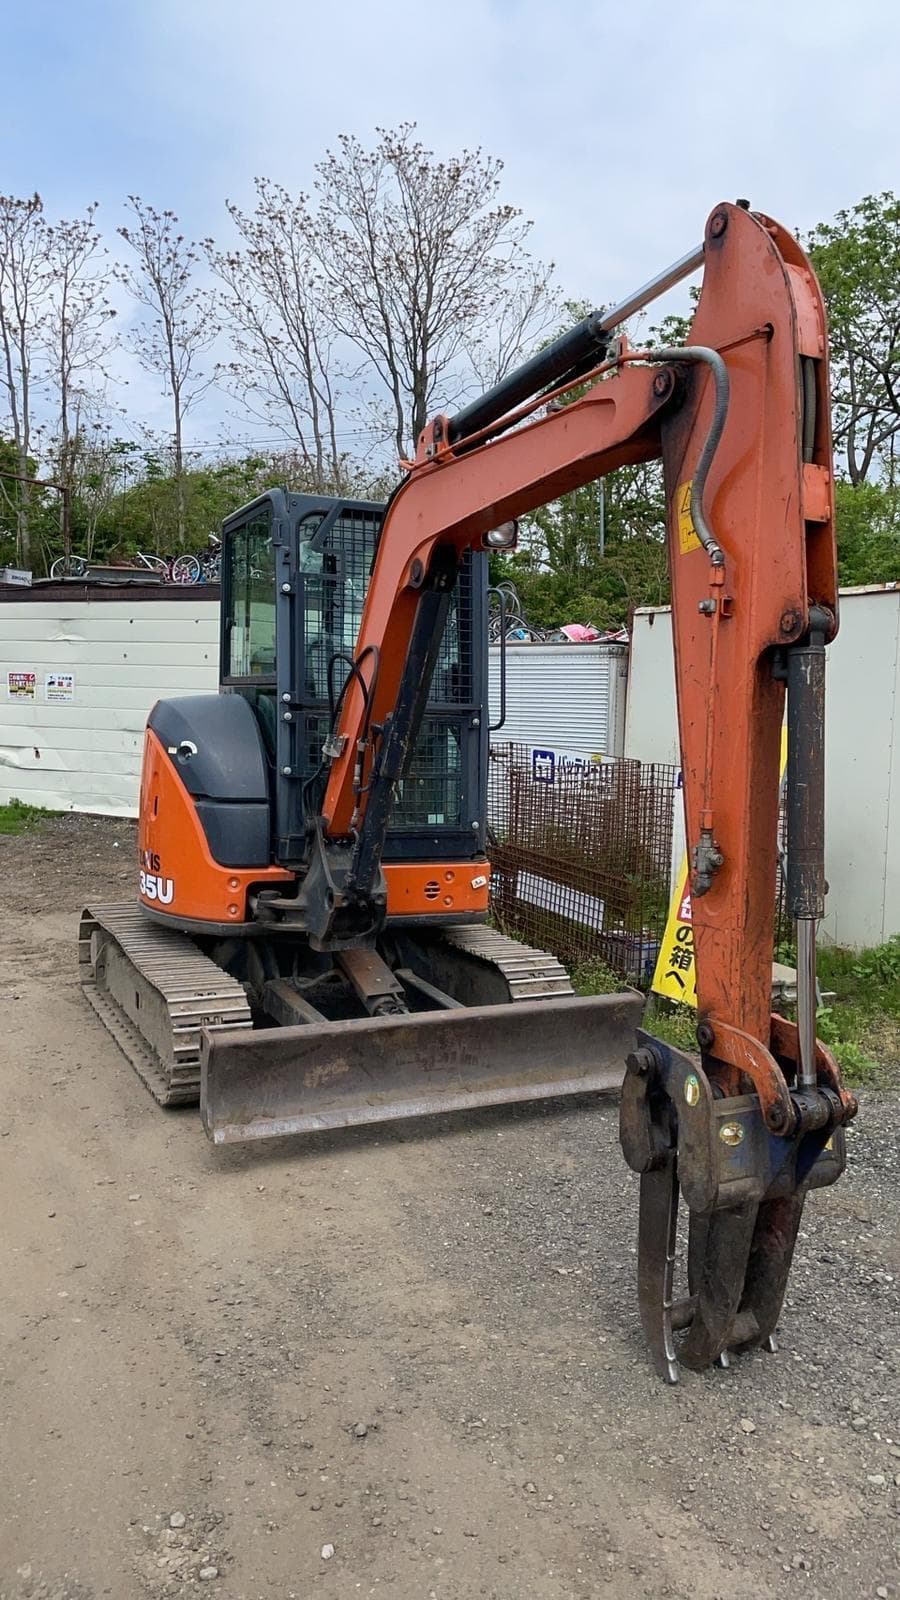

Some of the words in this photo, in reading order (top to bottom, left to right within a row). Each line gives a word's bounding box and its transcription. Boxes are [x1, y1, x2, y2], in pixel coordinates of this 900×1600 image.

[139, 870, 174, 904] 35U
[665, 926, 694, 989] の箱へ
